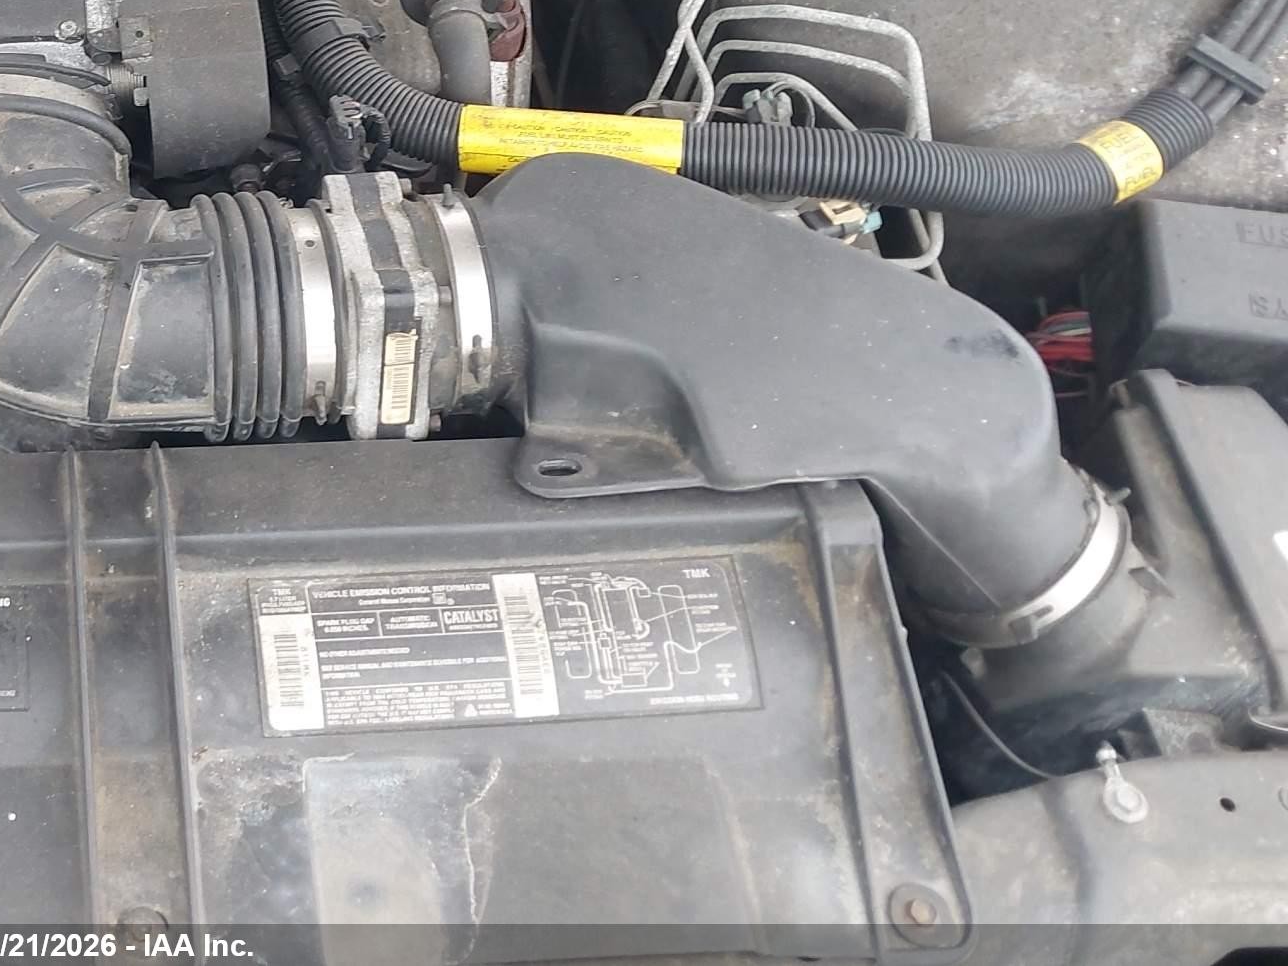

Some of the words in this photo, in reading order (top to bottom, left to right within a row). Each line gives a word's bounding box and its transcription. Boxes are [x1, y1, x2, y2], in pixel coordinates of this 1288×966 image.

[682, 569, 711, 578] TMK
[312, 590, 349, 598] VEHICLE
[349, 588, 390, 596] EMISSION
[391, 586, 431, 595] CONTROL
[443, 609, 499, 624] CATALYST
